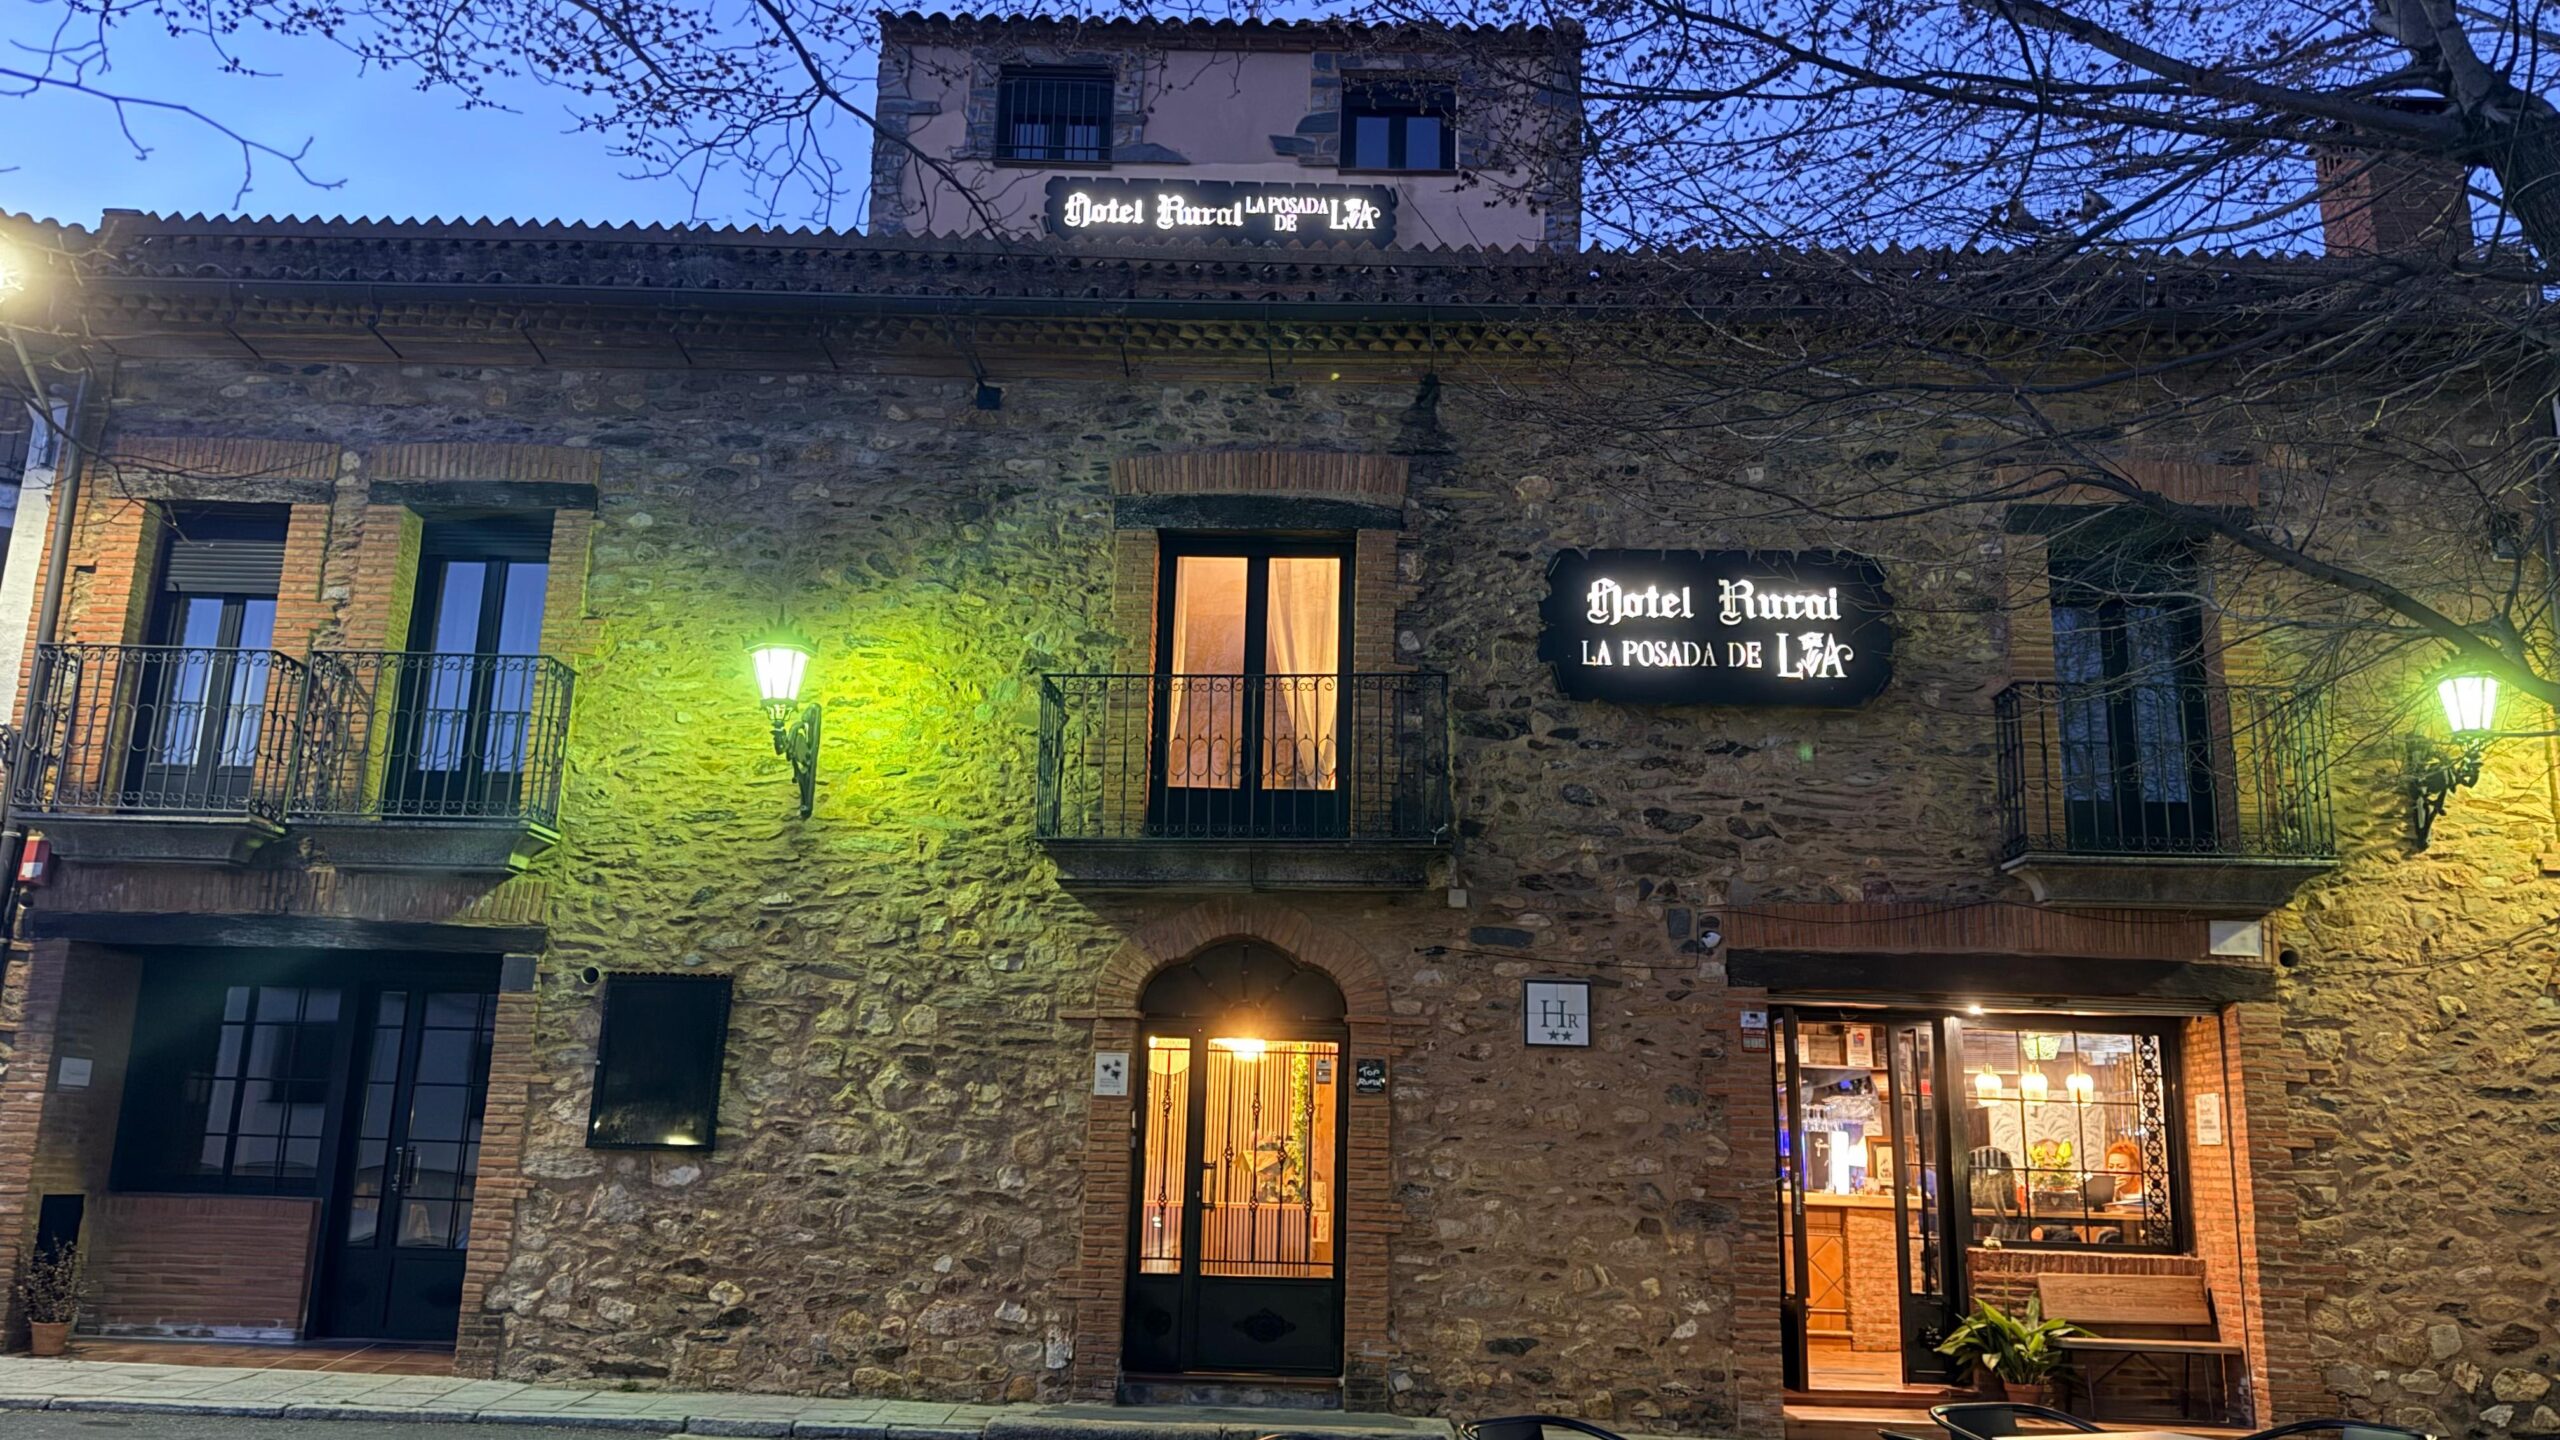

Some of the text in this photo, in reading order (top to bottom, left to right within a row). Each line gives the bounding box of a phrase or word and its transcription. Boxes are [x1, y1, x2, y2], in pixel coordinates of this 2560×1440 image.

[1064, 192, 1243, 229] Hotel Rural
[1246, 197, 1329, 214] LA POSADA
[1275, 214, 1297, 231] DE
[1587, 578, 1841, 625] Hotel Rural
[1582, 640, 1612, 666] LA
[1622, 640, 1716, 667] POSADA
[1728, 642, 1762, 668] DE
[1541, 1000, 1579, 1028] HR
